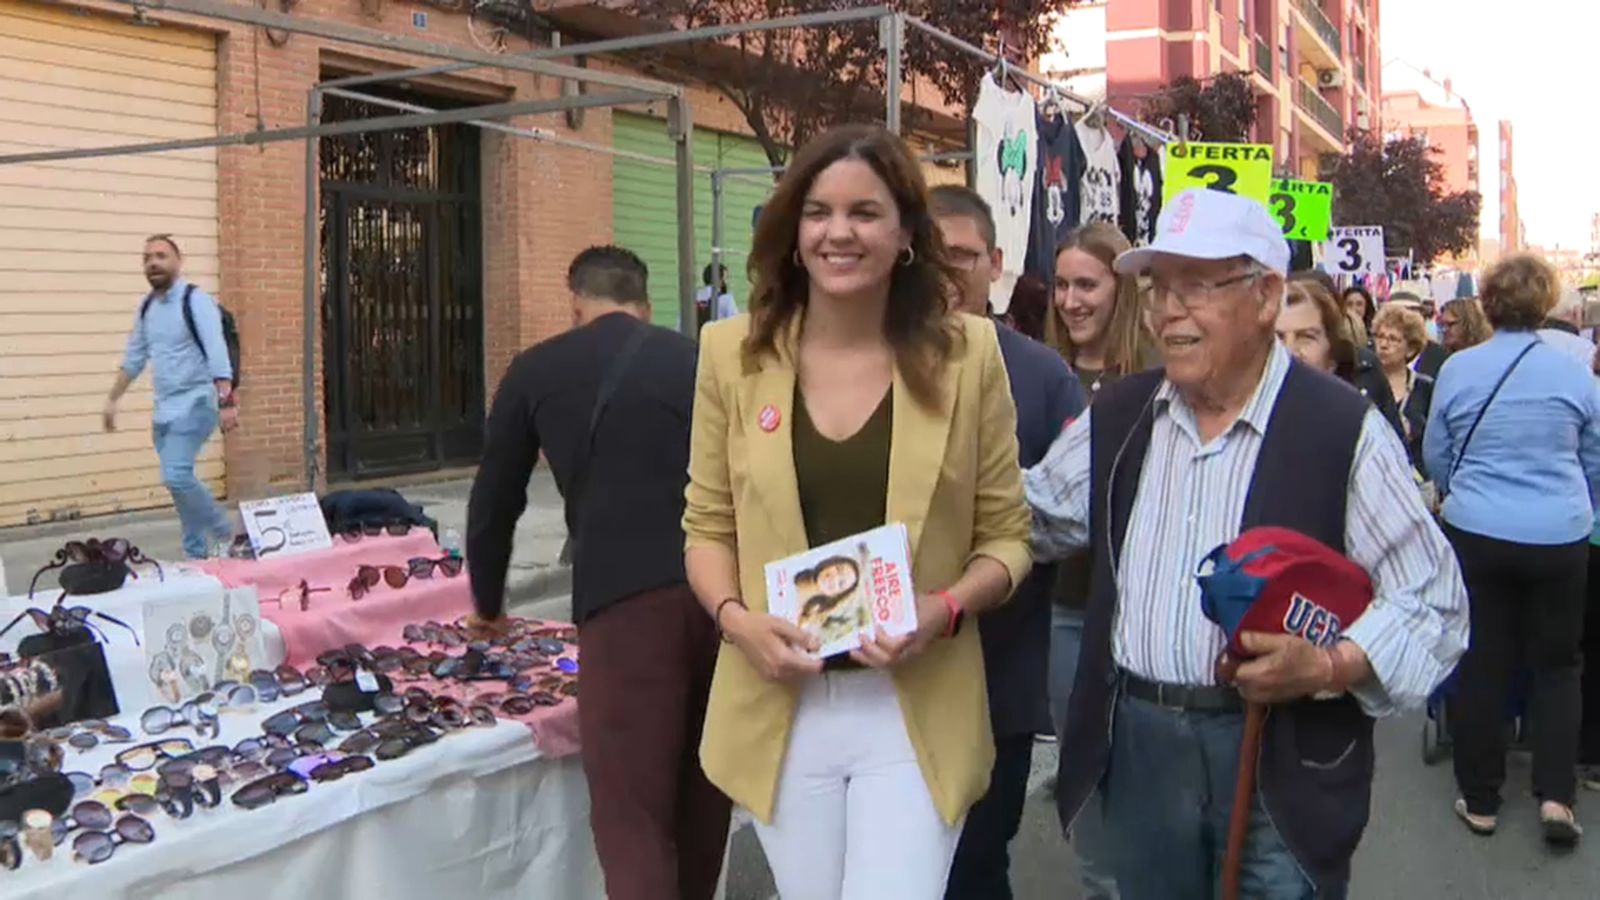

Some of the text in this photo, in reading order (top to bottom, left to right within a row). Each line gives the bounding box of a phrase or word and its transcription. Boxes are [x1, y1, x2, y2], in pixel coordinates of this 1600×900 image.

[1170, 145, 1270, 160] OFERTA
[1269, 193, 1296, 234] 3
[1337, 238, 1362, 271] 3
[254, 510, 286, 557] 5
[872, 556, 890, 621] FRESCO
[885, 563, 901, 597] AIRE
